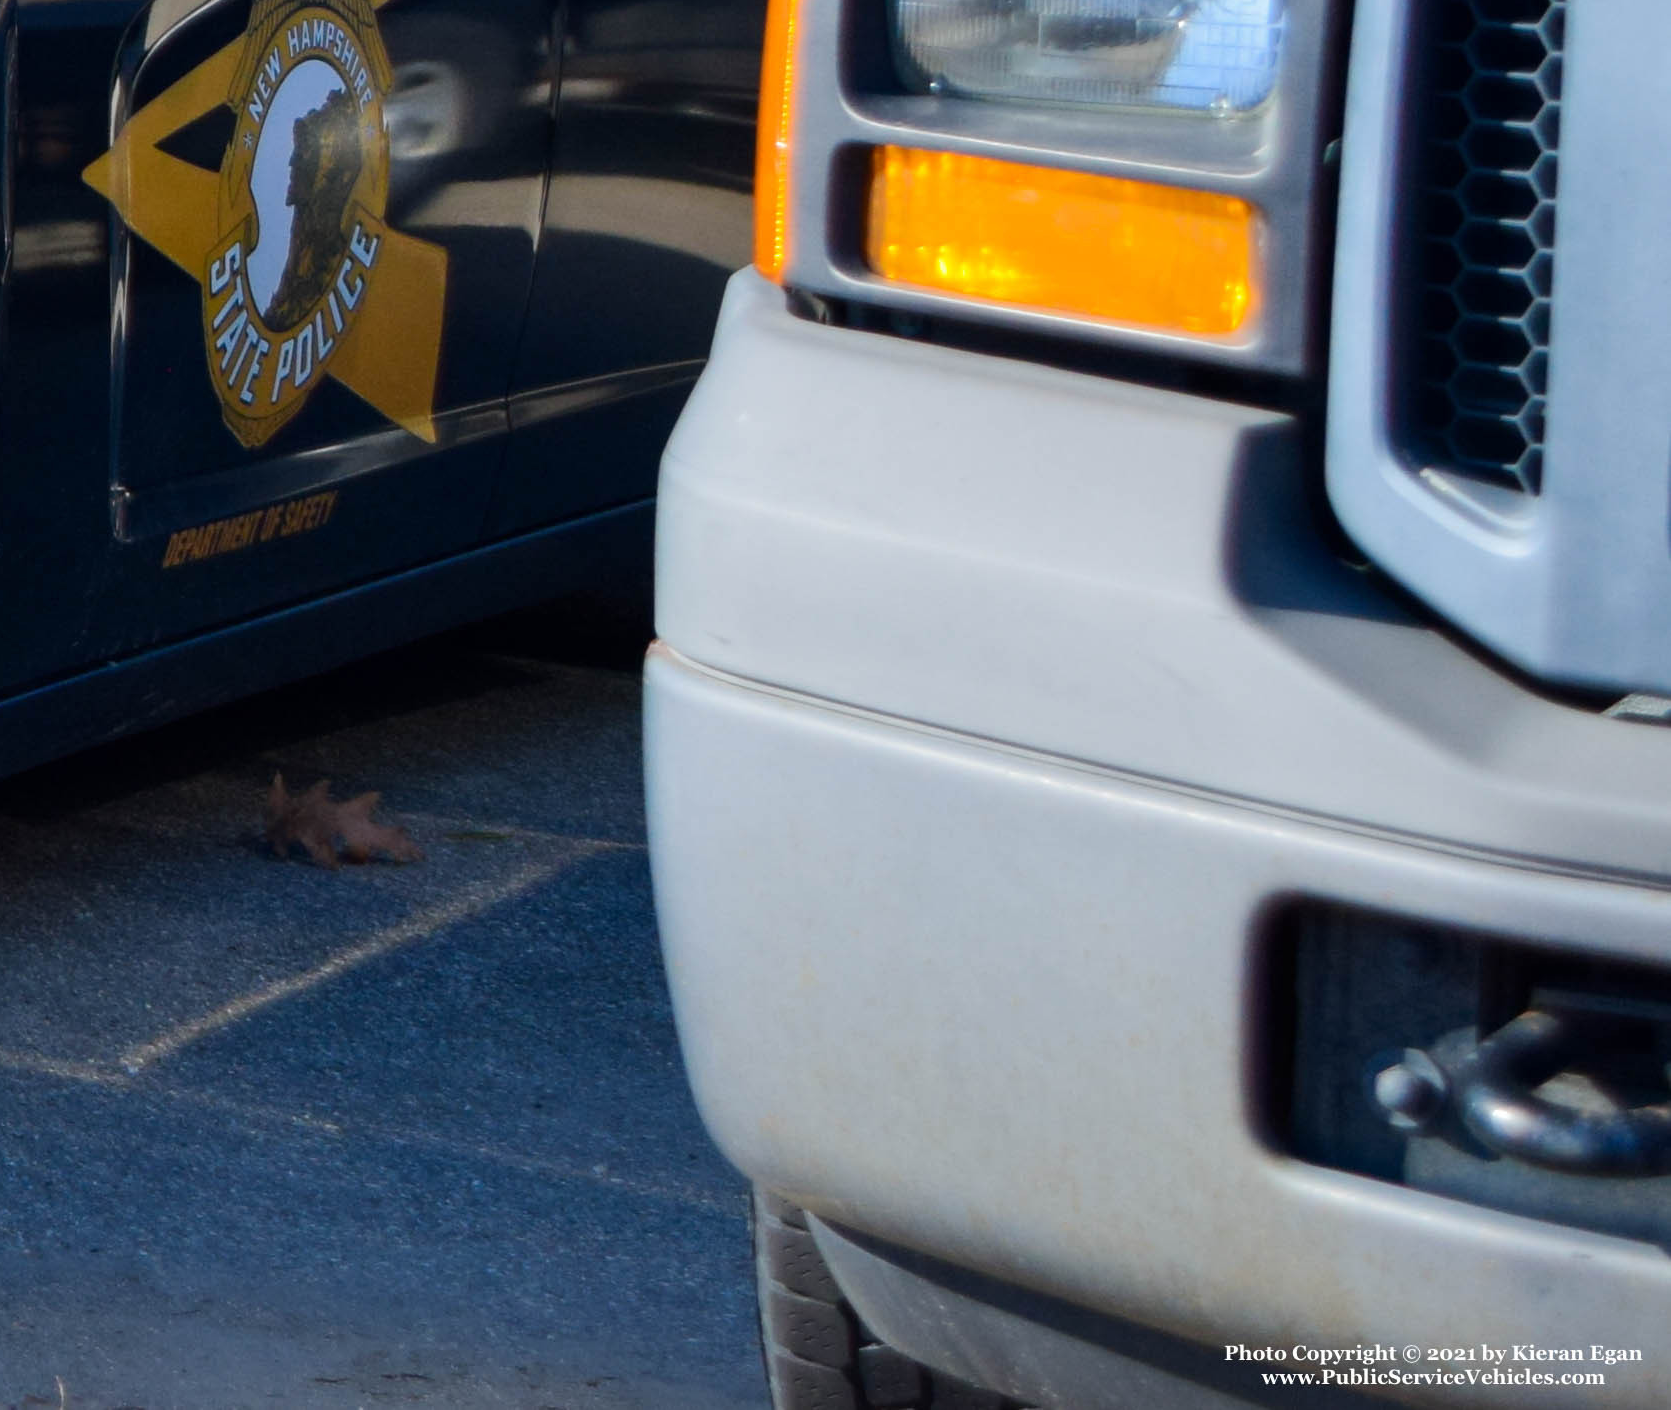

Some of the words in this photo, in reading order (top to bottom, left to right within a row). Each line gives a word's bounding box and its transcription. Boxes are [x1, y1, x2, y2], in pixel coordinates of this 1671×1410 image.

[248, 46, 283, 122] NEW
[287, 18, 372, 114] HAMPSHIRE
[210, 242, 270, 404] STATE
[271, 224, 380, 403] POLICE
[163, 509, 264, 568] DEPARTMENT
[260, 504, 284, 542] OF
[281, 490, 339, 537] SAFETY
